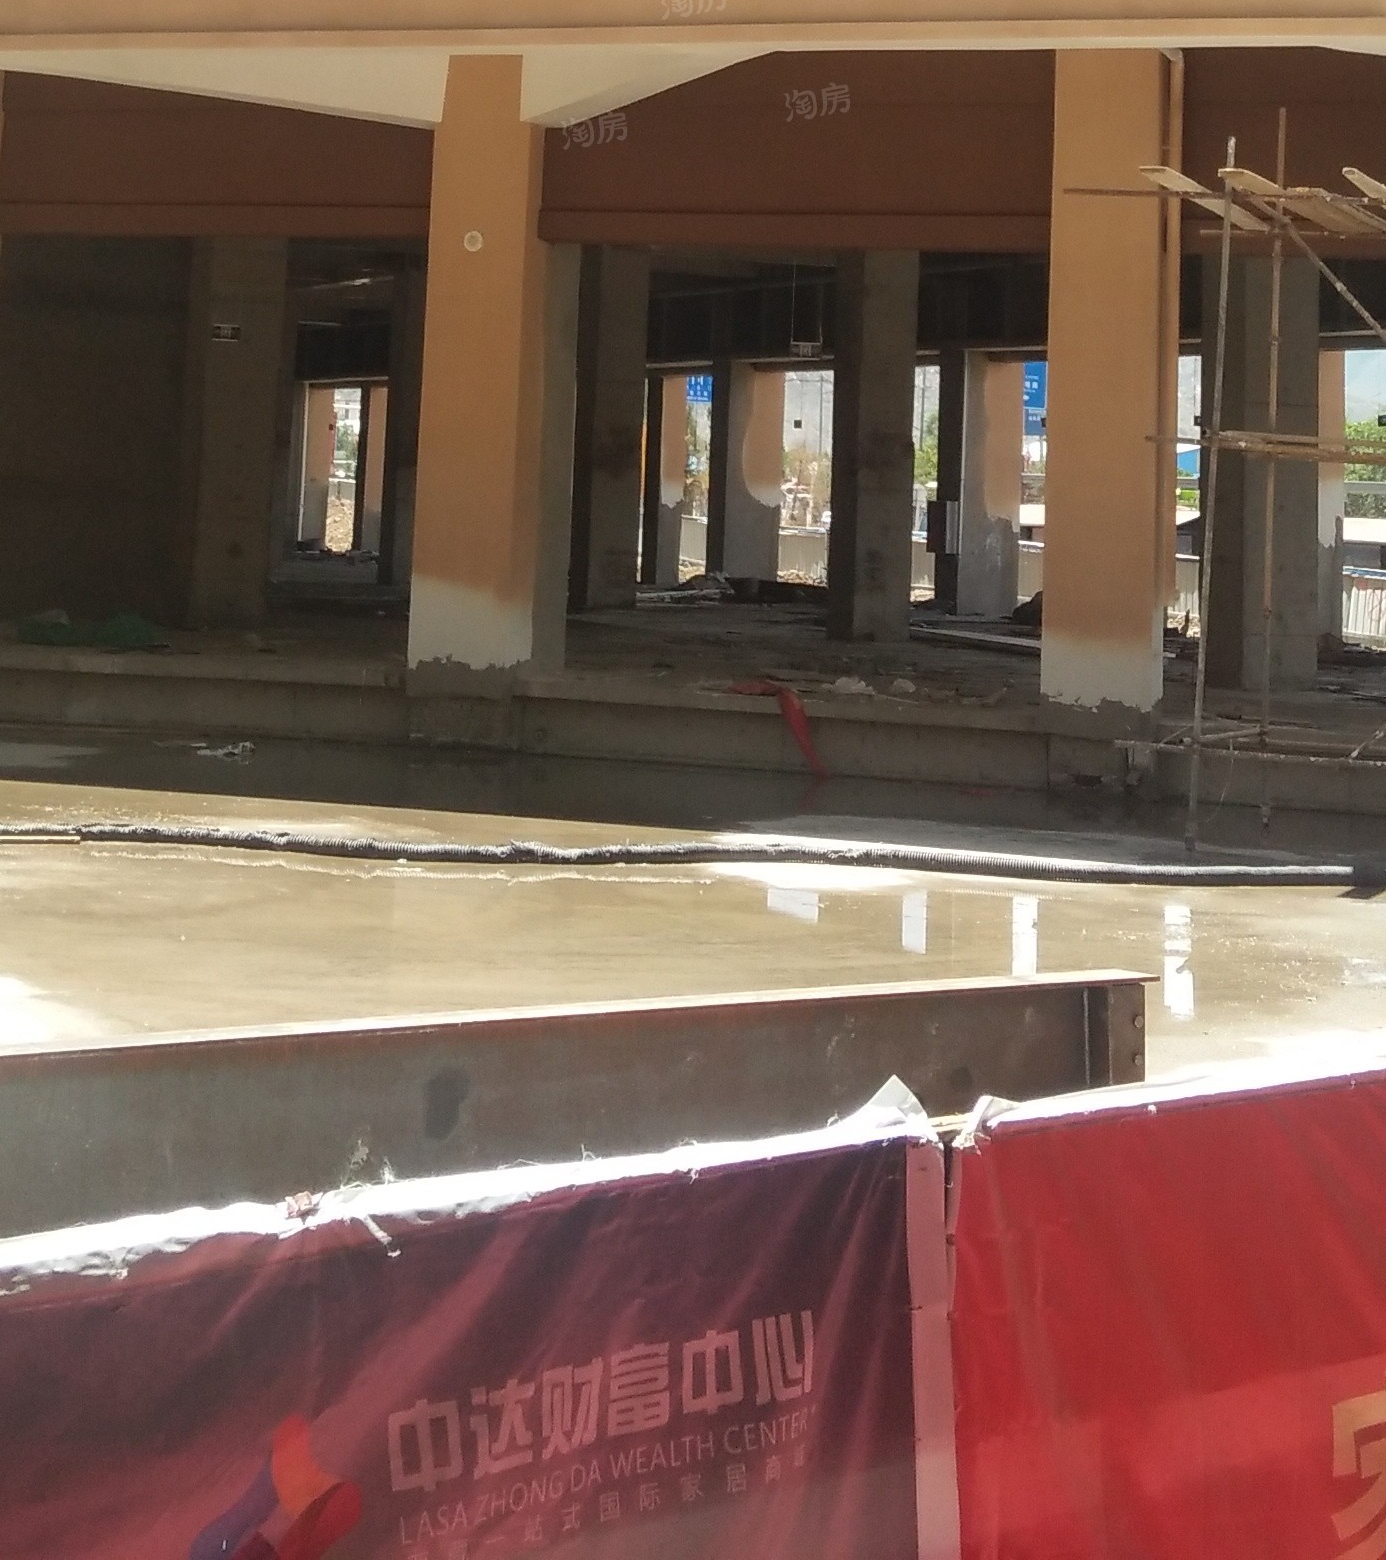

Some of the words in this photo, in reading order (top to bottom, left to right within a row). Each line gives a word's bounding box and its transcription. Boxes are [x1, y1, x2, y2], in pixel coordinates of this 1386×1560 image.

[388, 1308, 815, 1493] 中达财富中心
[399, 1500, 468, 1545] LASA
[474, 1470, 564, 1523] ZHONG
[569, 1460, 603, 1493] DA
[611, 1434, 715, 1481] WEALTH
[722, 1408, 811, 1455] CENTER
